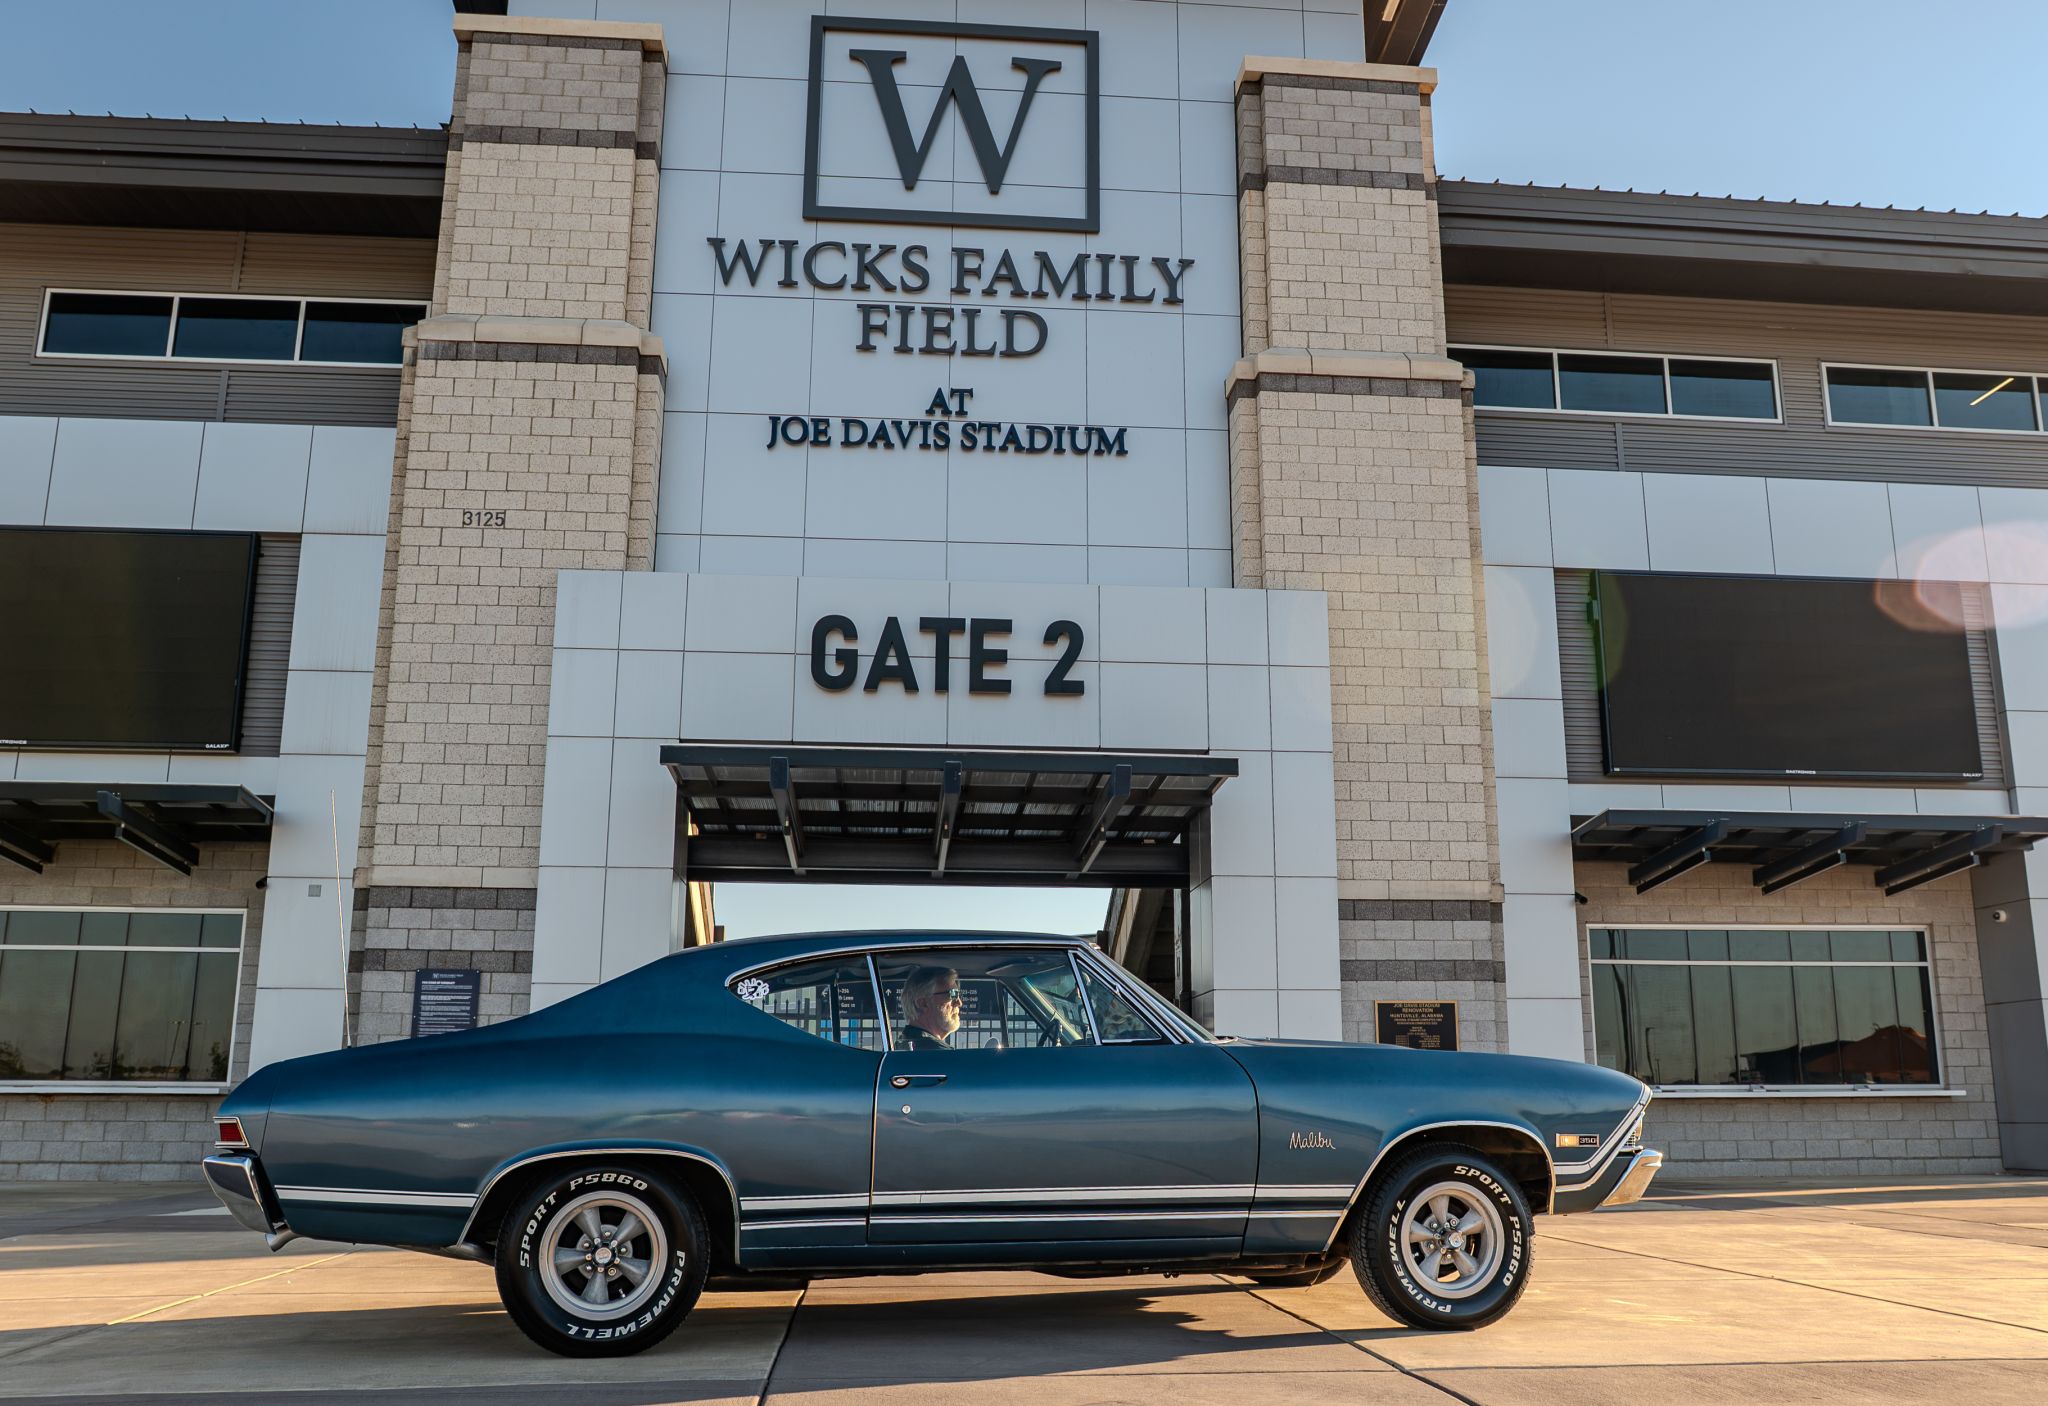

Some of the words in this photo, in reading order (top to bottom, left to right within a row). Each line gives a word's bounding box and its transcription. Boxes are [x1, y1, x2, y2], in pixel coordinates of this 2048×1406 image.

[849, 48, 1062, 195] W
[706, 237, 930, 293] WICKS
[950, 247, 1195, 304] FAMILY
[855, 303, 1049, 358] FIELD
[767, 416, 831, 449] JOE
[841, 418, 950, 451] DAVIS
[960, 421, 1128, 455] STADIUM
[926, 387, 973, 416] AT
[463, 510, 505, 527] 3125
[810, 614, 1013, 695] GATE
[1043, 619, 1085, 697] 2
[1289, 1131, 1336, 1150] Malibu
[520, 1191, 557, 1268] SPORT
[569, 1172, 648, 1191] PS860
[1388, 1199, 1452, 1313] PRIMEWELL
[1454, 1165, 1512, 1206] SPORT
[1503, 1215, 1522, 1287] PS860
[566, 1250, 686, 1339] PRIMEWELL
